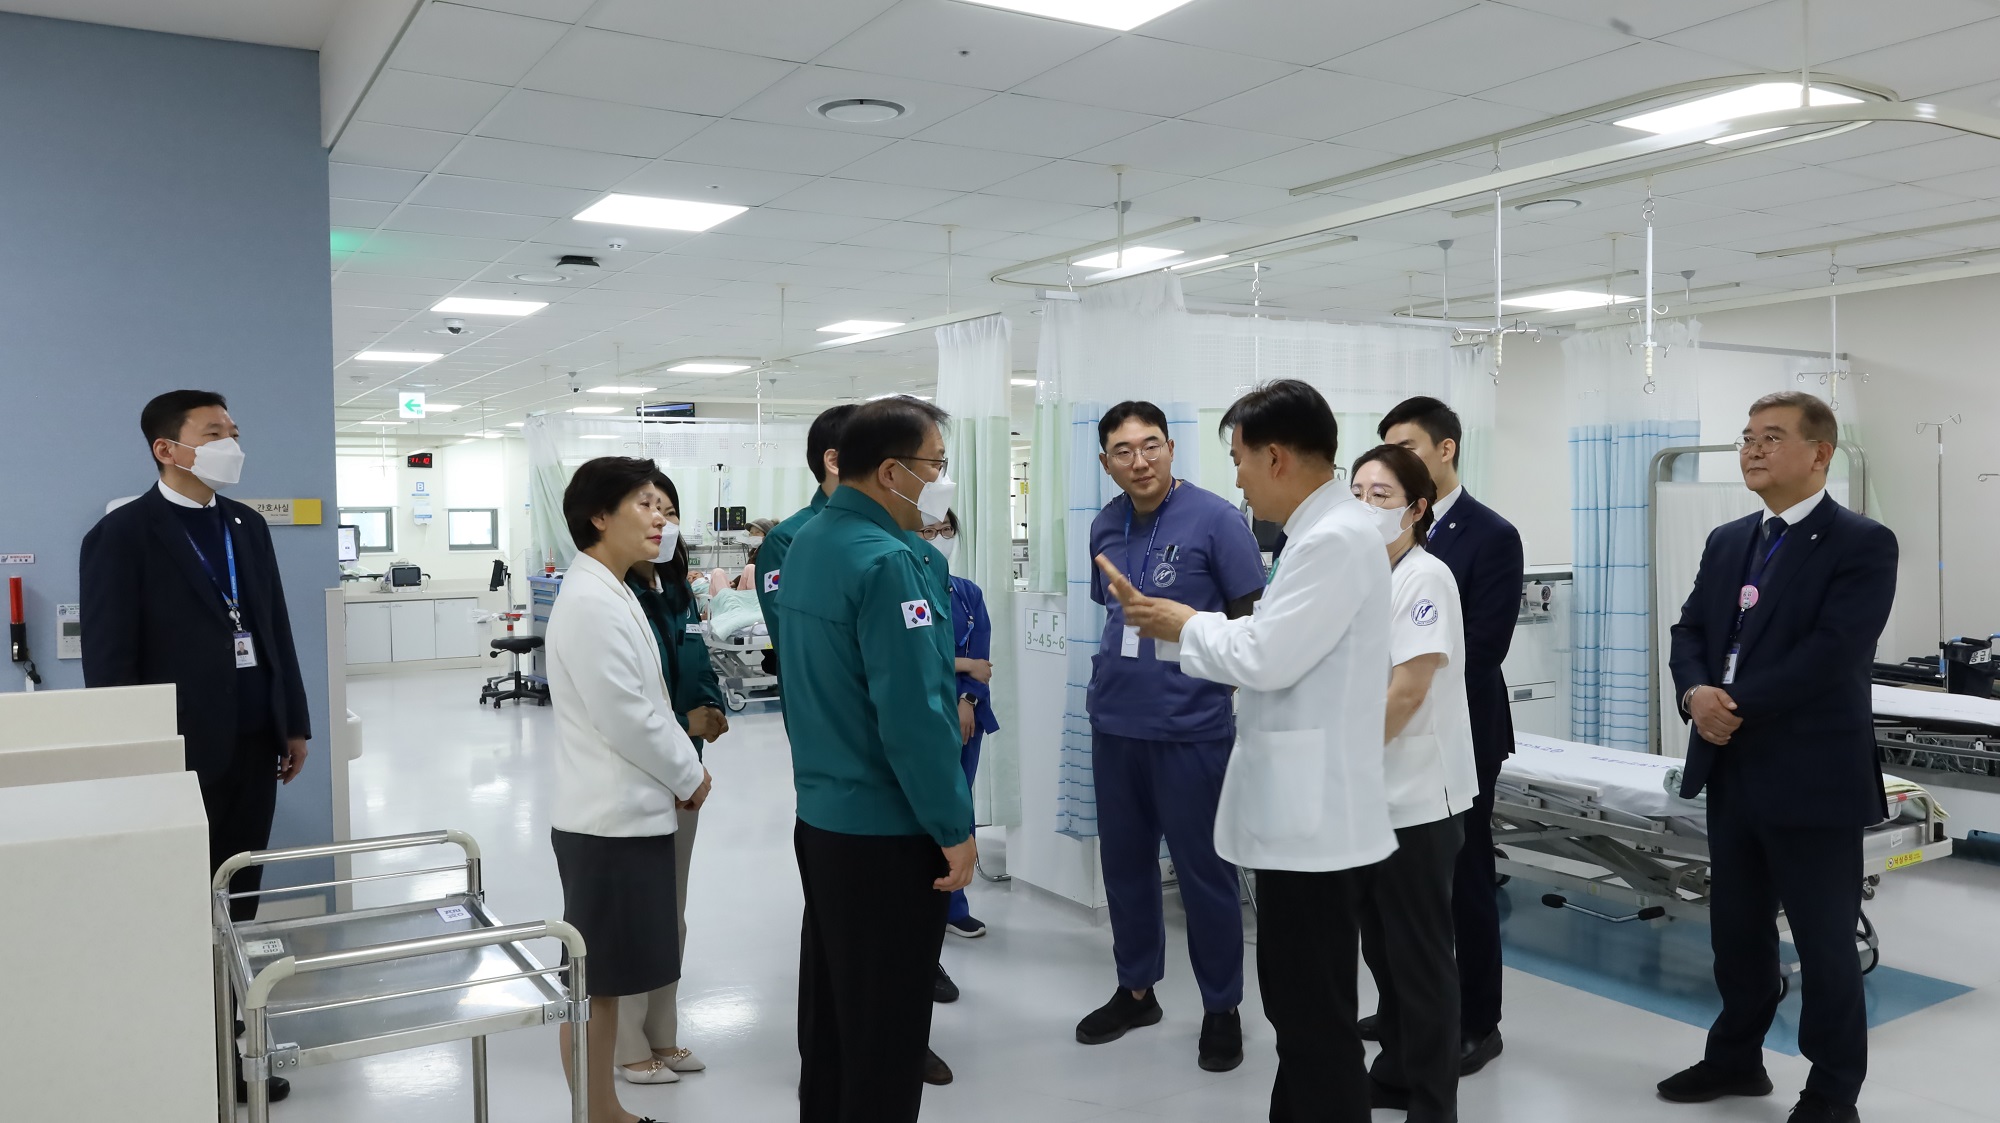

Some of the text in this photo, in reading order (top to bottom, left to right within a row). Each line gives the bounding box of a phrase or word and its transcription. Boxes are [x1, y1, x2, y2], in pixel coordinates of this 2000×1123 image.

[257, 503, 289, 512] 간호사실
[1032, 612, 1059, 632] F F
[1026, 631, 1065, 650] 3~4 5~6
